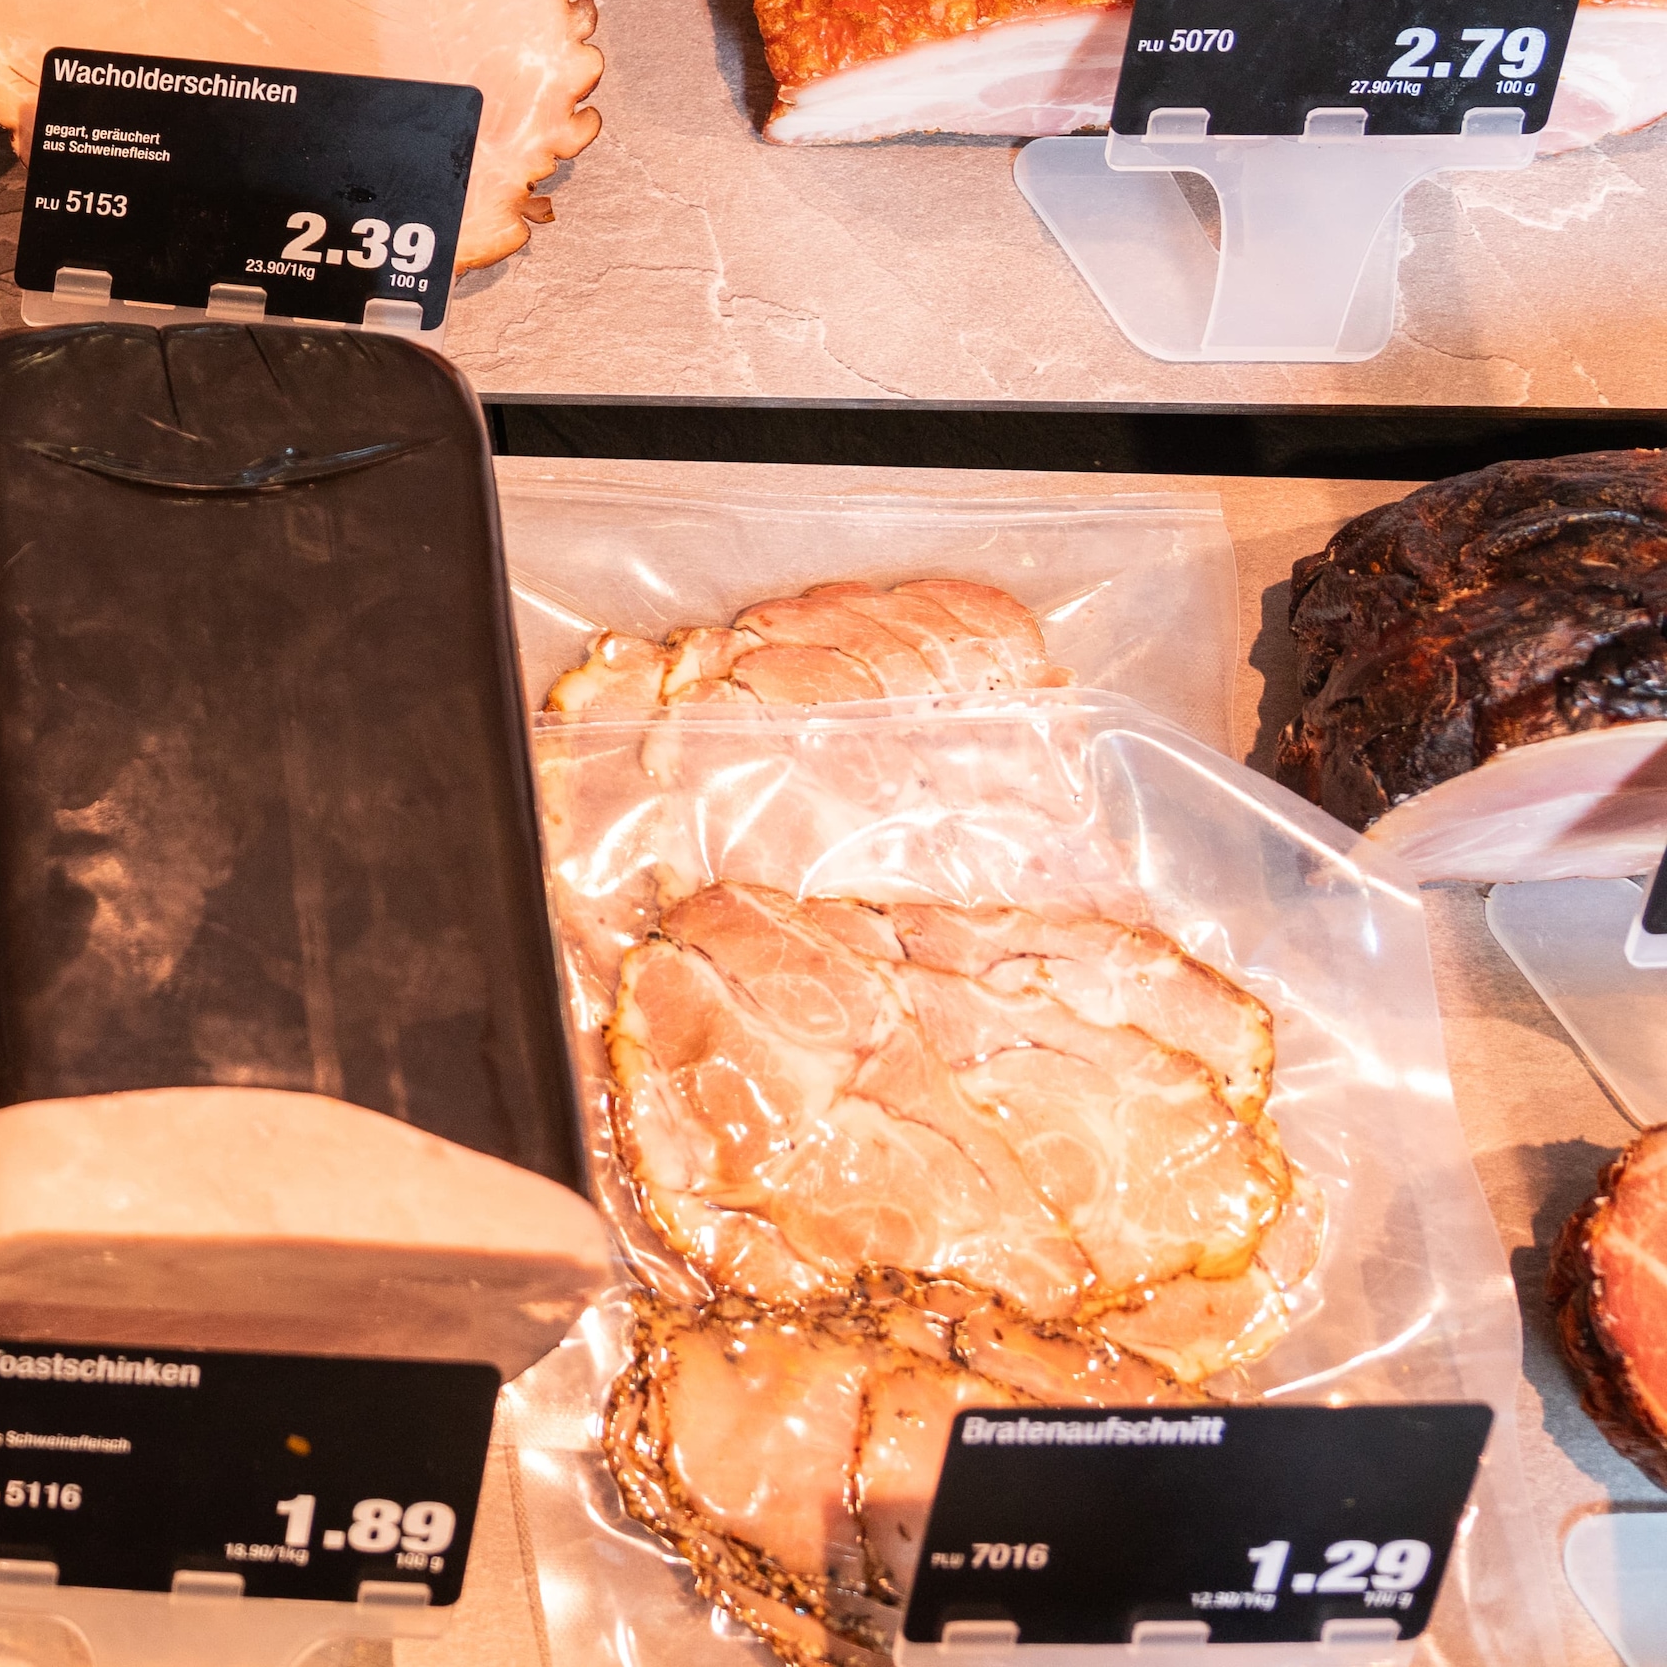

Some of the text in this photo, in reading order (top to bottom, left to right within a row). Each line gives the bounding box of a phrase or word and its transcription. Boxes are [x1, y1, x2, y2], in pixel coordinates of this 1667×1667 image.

[1169, 28, 1235, 53] 5070
[1386, 26, 1547, 79] 2.79
[54, 58, 298, 104] Wacholderschinken
[1349, 79, 1422, 97] 27.90/1kg
[44, 124, 161, 145] gegart, geräuchert
[42, 140, 171, 162] aus Schweinefleisch
[65, 189, 128, 218] 5153
[280, 212, 436, 272] 2.39
[245, 258, 316, 281] 23.90/1kg
[961, 1415, 1225, 1444] Bratenaufschnitt
[5, 1479, 81, 1509] 5116
[277, 1494, 456, 1555] 1.89
[972, 1543, 1049, 1568] 7016
[1248, 1539, 1431, 1594] 1.29
